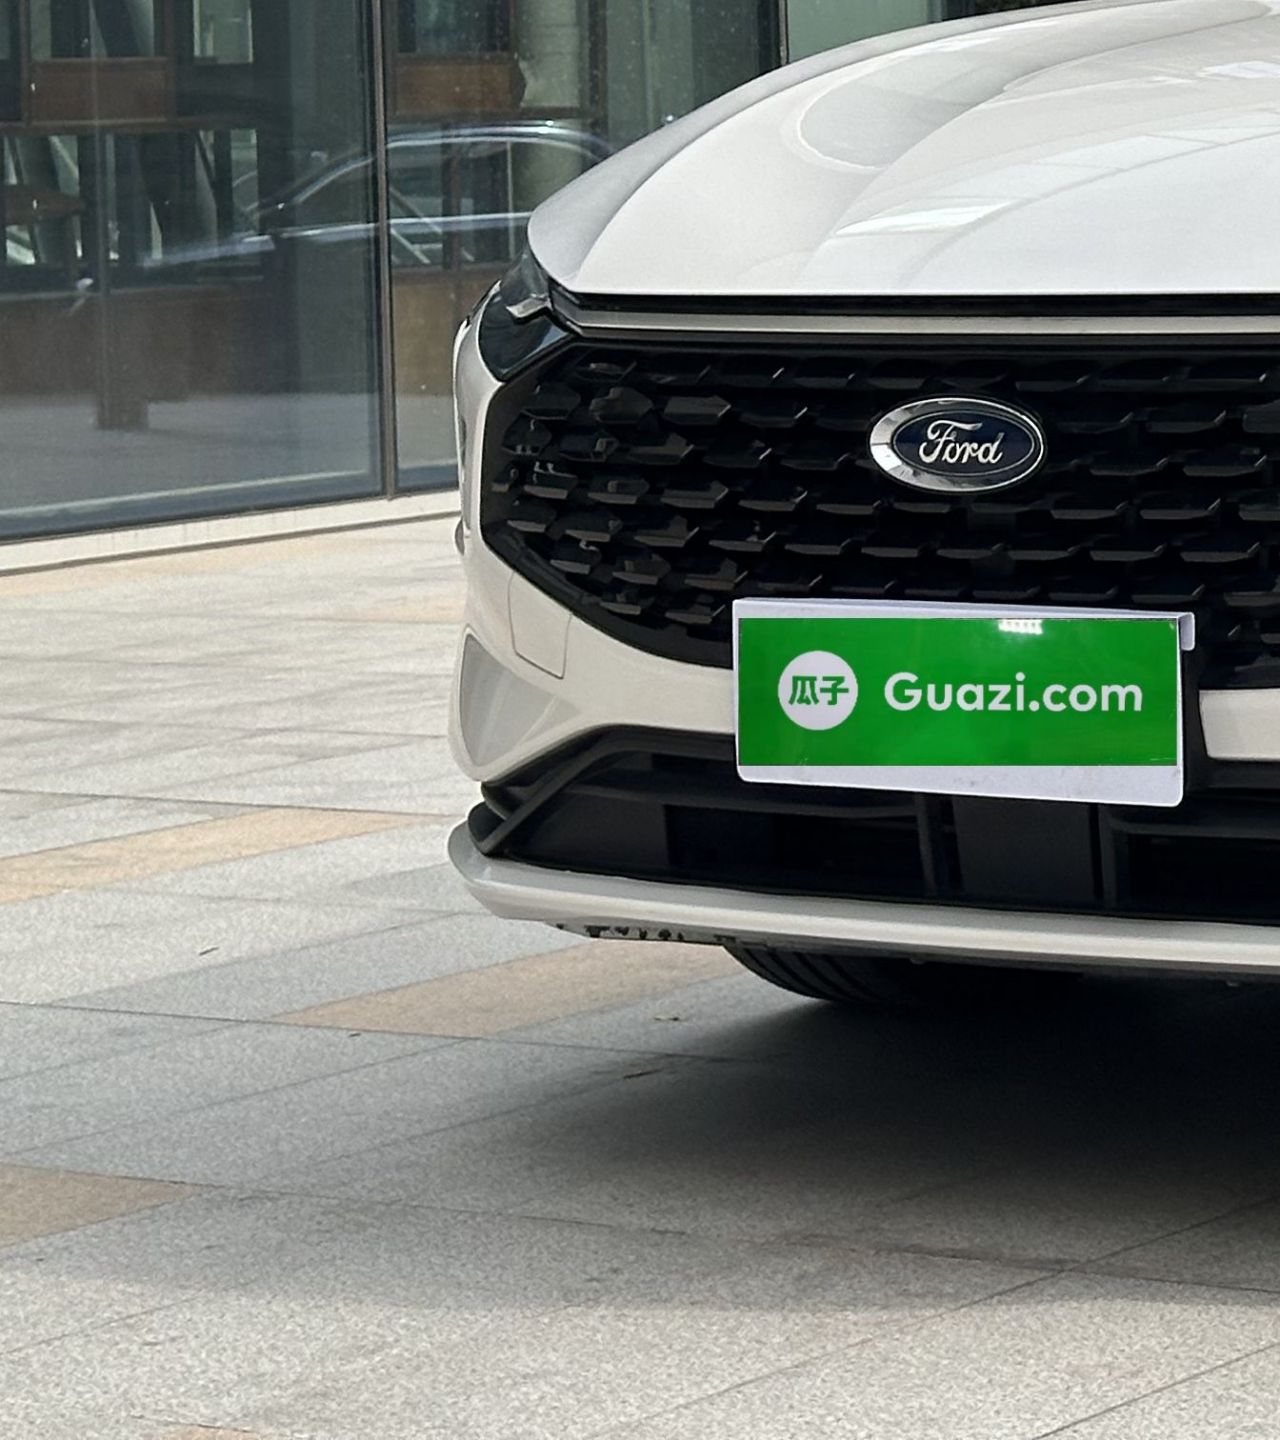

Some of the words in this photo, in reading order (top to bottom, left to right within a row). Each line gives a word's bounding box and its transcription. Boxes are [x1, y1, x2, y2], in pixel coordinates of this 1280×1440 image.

[919, 420, 1004, 463] Ford
[788, 675, 849, 706] 瓜子
[884, 671, 1143, 711] Guazi.com
